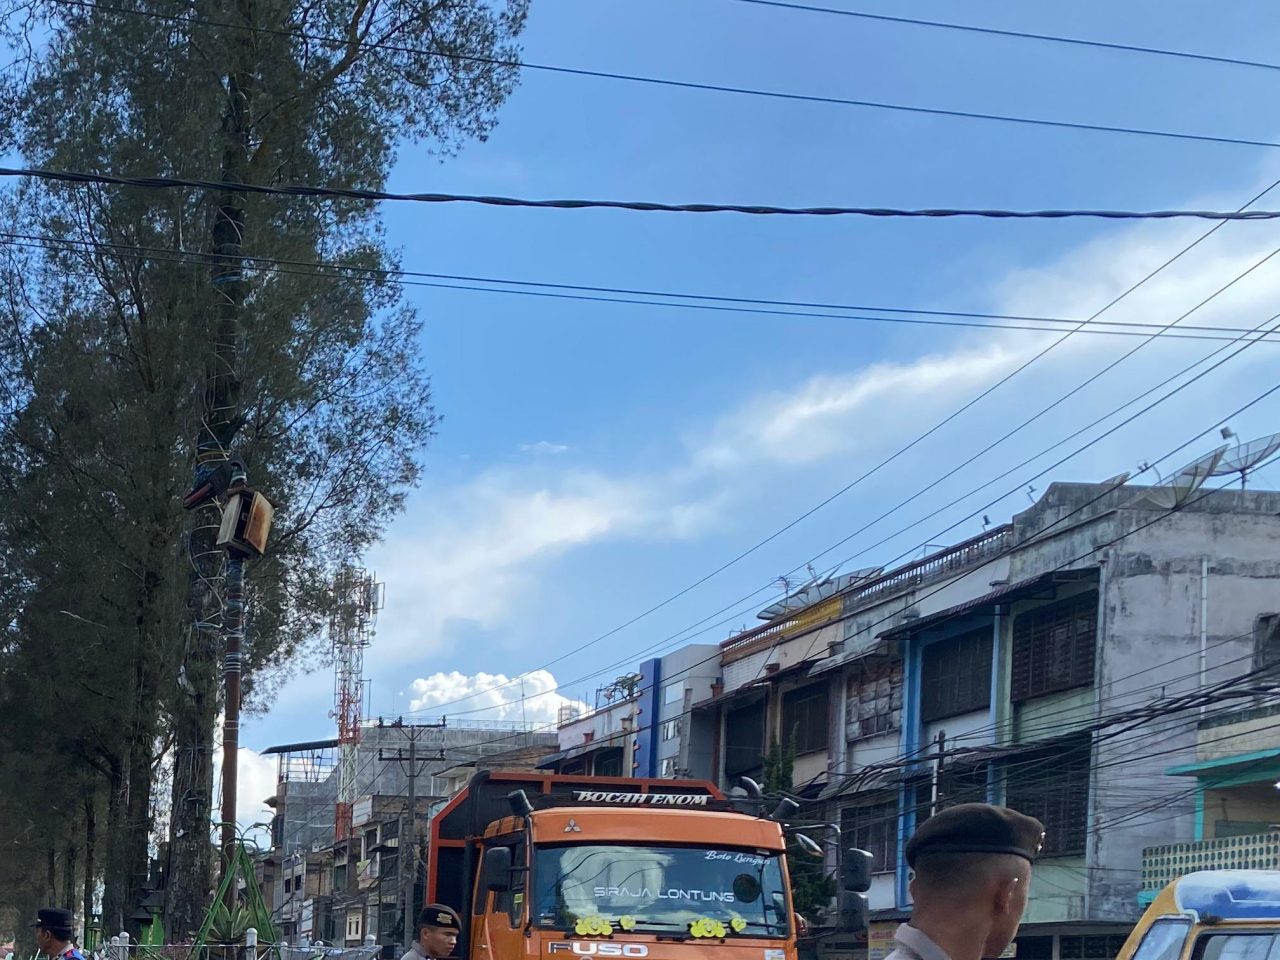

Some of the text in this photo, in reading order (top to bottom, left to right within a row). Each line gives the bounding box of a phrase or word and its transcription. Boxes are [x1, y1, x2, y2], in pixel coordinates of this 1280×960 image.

[577, 791, 708, 806] BOCAH ENOM
[593, 886, 735, 903] SIRAJA LONTUNG
[548, 941, 649, 957] FUSO
